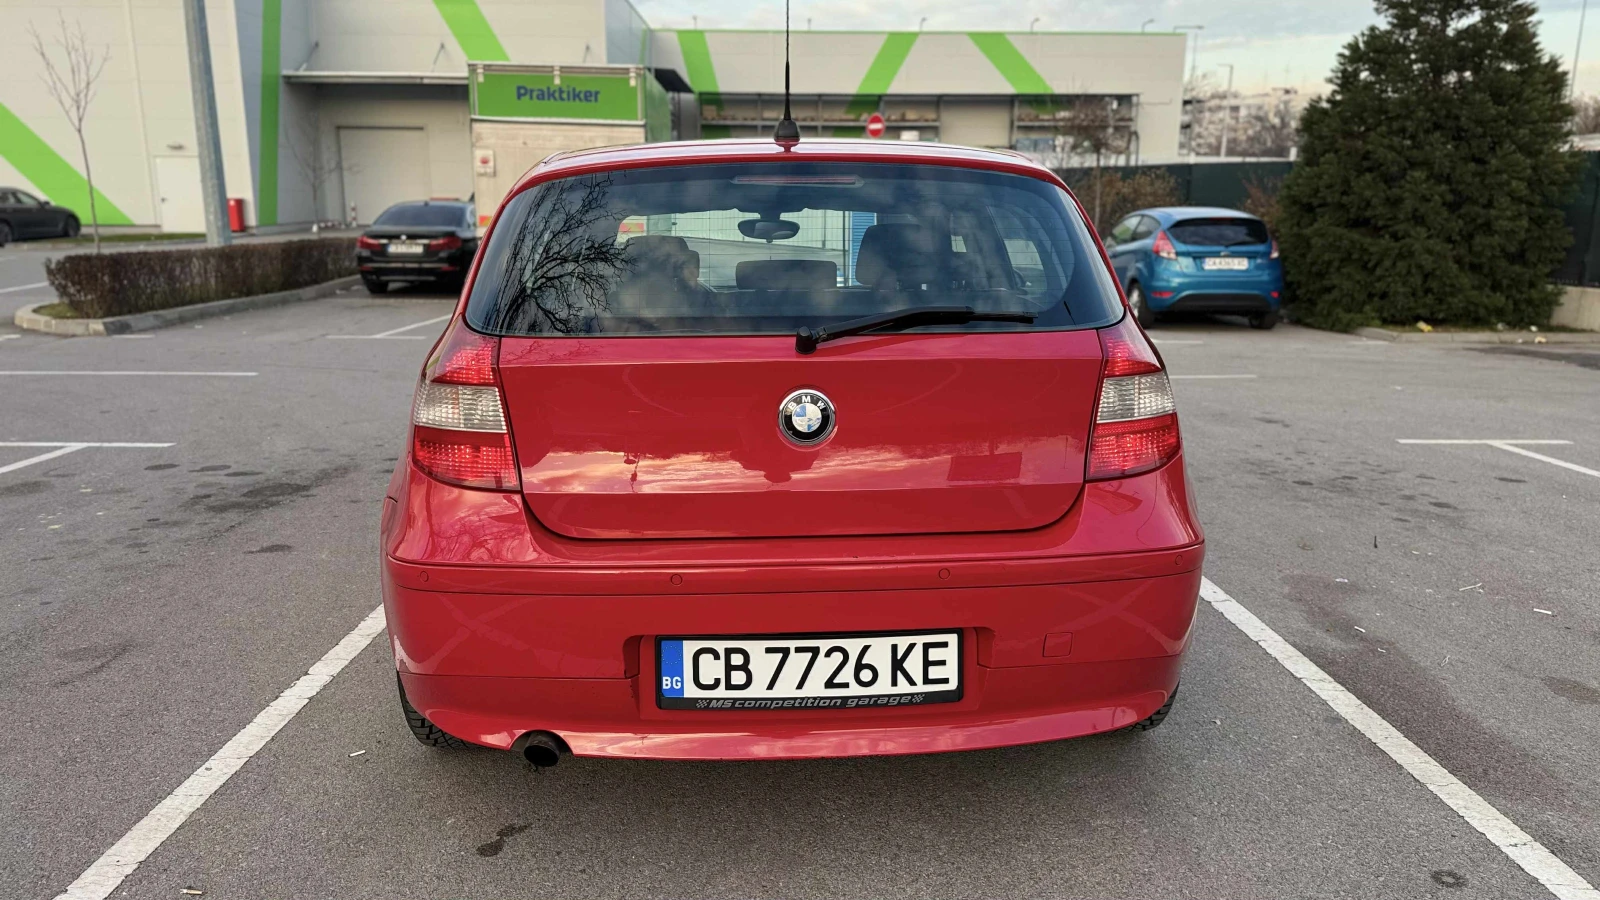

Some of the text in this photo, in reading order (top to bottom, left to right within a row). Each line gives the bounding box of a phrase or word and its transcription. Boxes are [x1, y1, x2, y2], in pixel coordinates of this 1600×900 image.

[516, 85, 600, 102] Praktiker
[787, 395, 827, 411] BMW
[692, 641, 950, 691] CB 7726 KE
[661, 676, 682, 690] BG
[709, 695, 912, 709] MS competition garage
